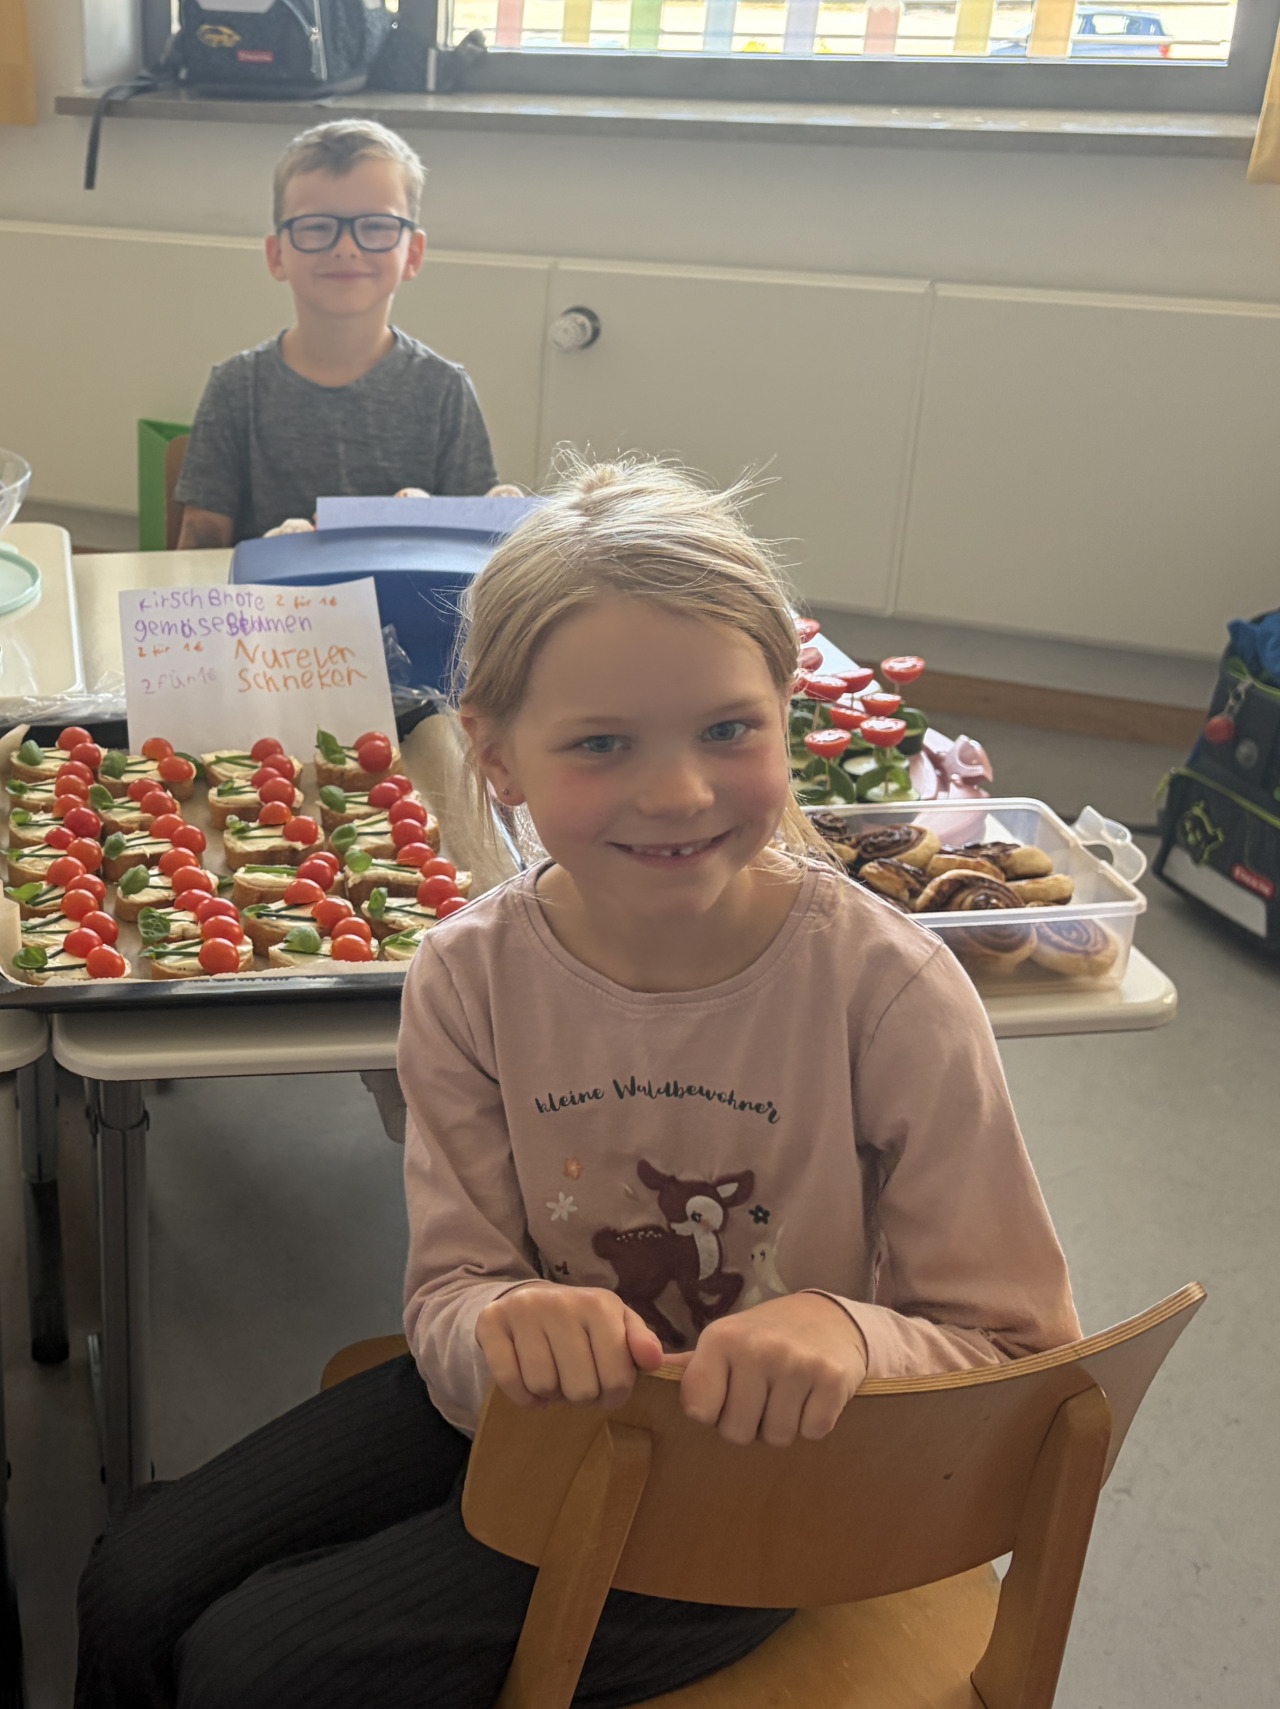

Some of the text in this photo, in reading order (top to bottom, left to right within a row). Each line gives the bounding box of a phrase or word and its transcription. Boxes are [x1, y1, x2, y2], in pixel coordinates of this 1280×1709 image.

[276, 594, 285, 607] 2
[138, 646, 147, 658] 2
[535, 1075, 781, 1124] kleine Waldbewohner
